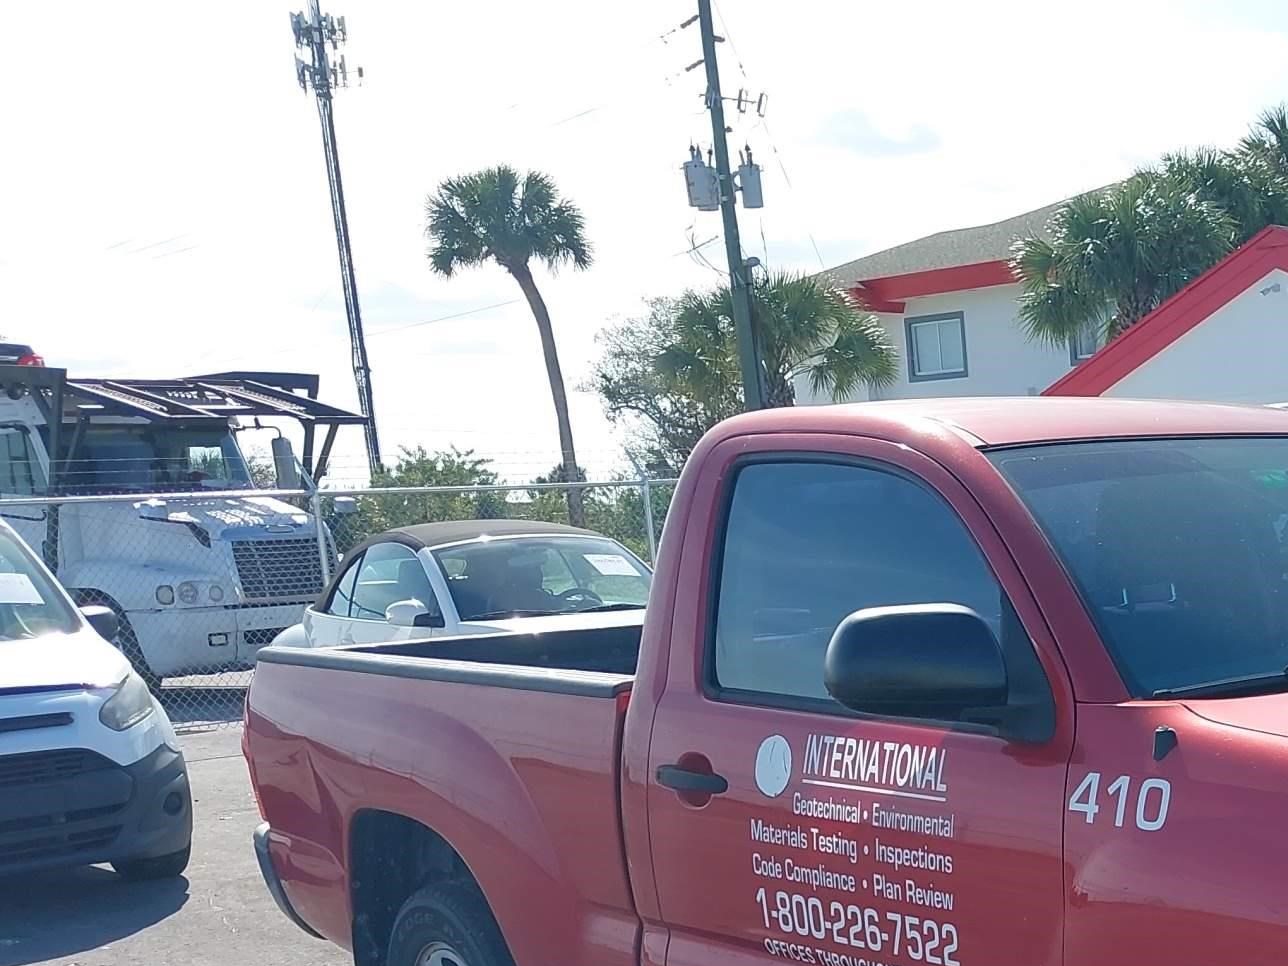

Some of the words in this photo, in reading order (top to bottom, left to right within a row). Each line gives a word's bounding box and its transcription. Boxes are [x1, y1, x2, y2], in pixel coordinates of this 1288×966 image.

[803, 733, 947, 792] INTERNATIONAL
[793, 791, 861, 825] Geotechnical
[872, 803, 955, 838] Environmental
[1068, 772, 1171, 831] 410
[750, 818, 808, 849] Materials
[810, 827, 857, 864] Testing
[875, 838, 953, 873] Inspections
[752, 853, 782, 879] Code
[785, 859, 856, 892] Compliance
[873, 873, 902, 901] Plan
[905, 879, 954, 911] Review
[764, 938, 816, 965] OFFICES
